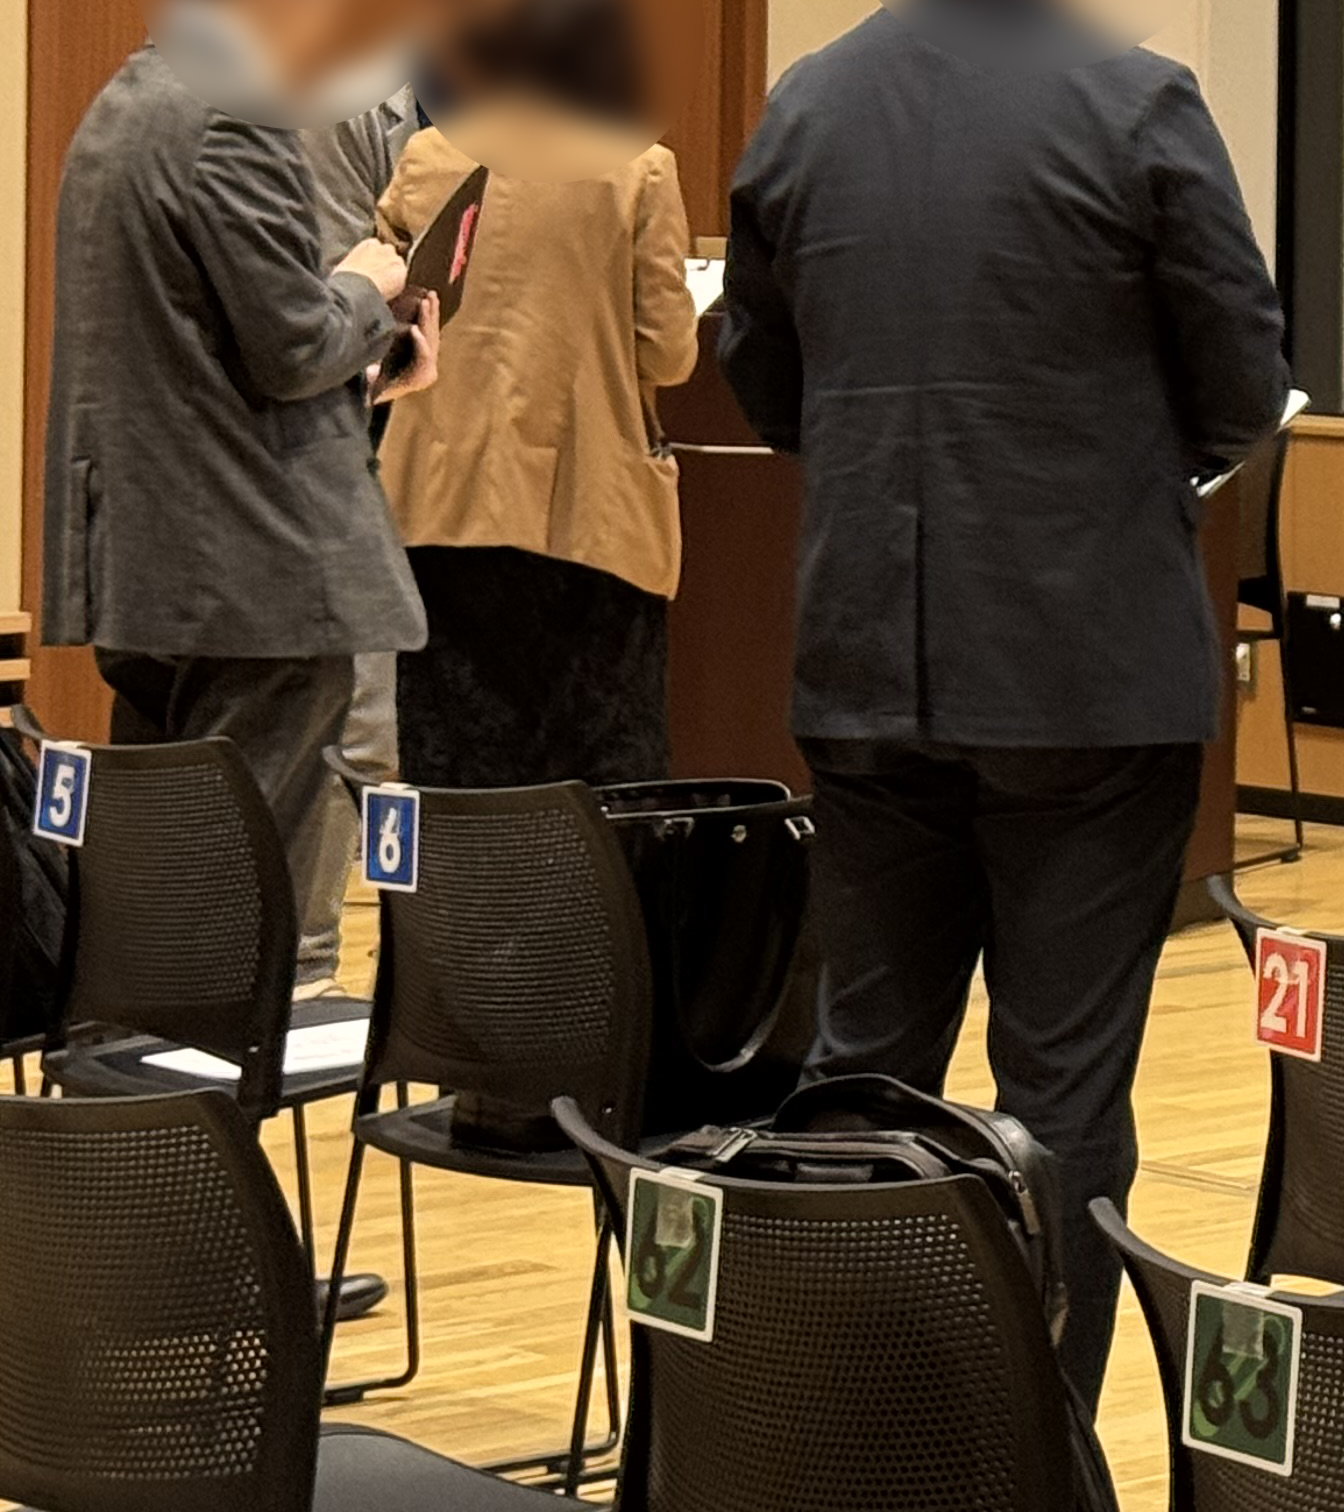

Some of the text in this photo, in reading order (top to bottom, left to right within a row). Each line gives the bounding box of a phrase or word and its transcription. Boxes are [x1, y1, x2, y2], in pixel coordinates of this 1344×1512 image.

[49, 764, 76, 828] 5
[379, 807, 401, 874] 6
[1260, 951, 1309, 1039] 21
[636, 1197, 706, 1310] 62
[1198, 1314, 1281, 1440] 63
